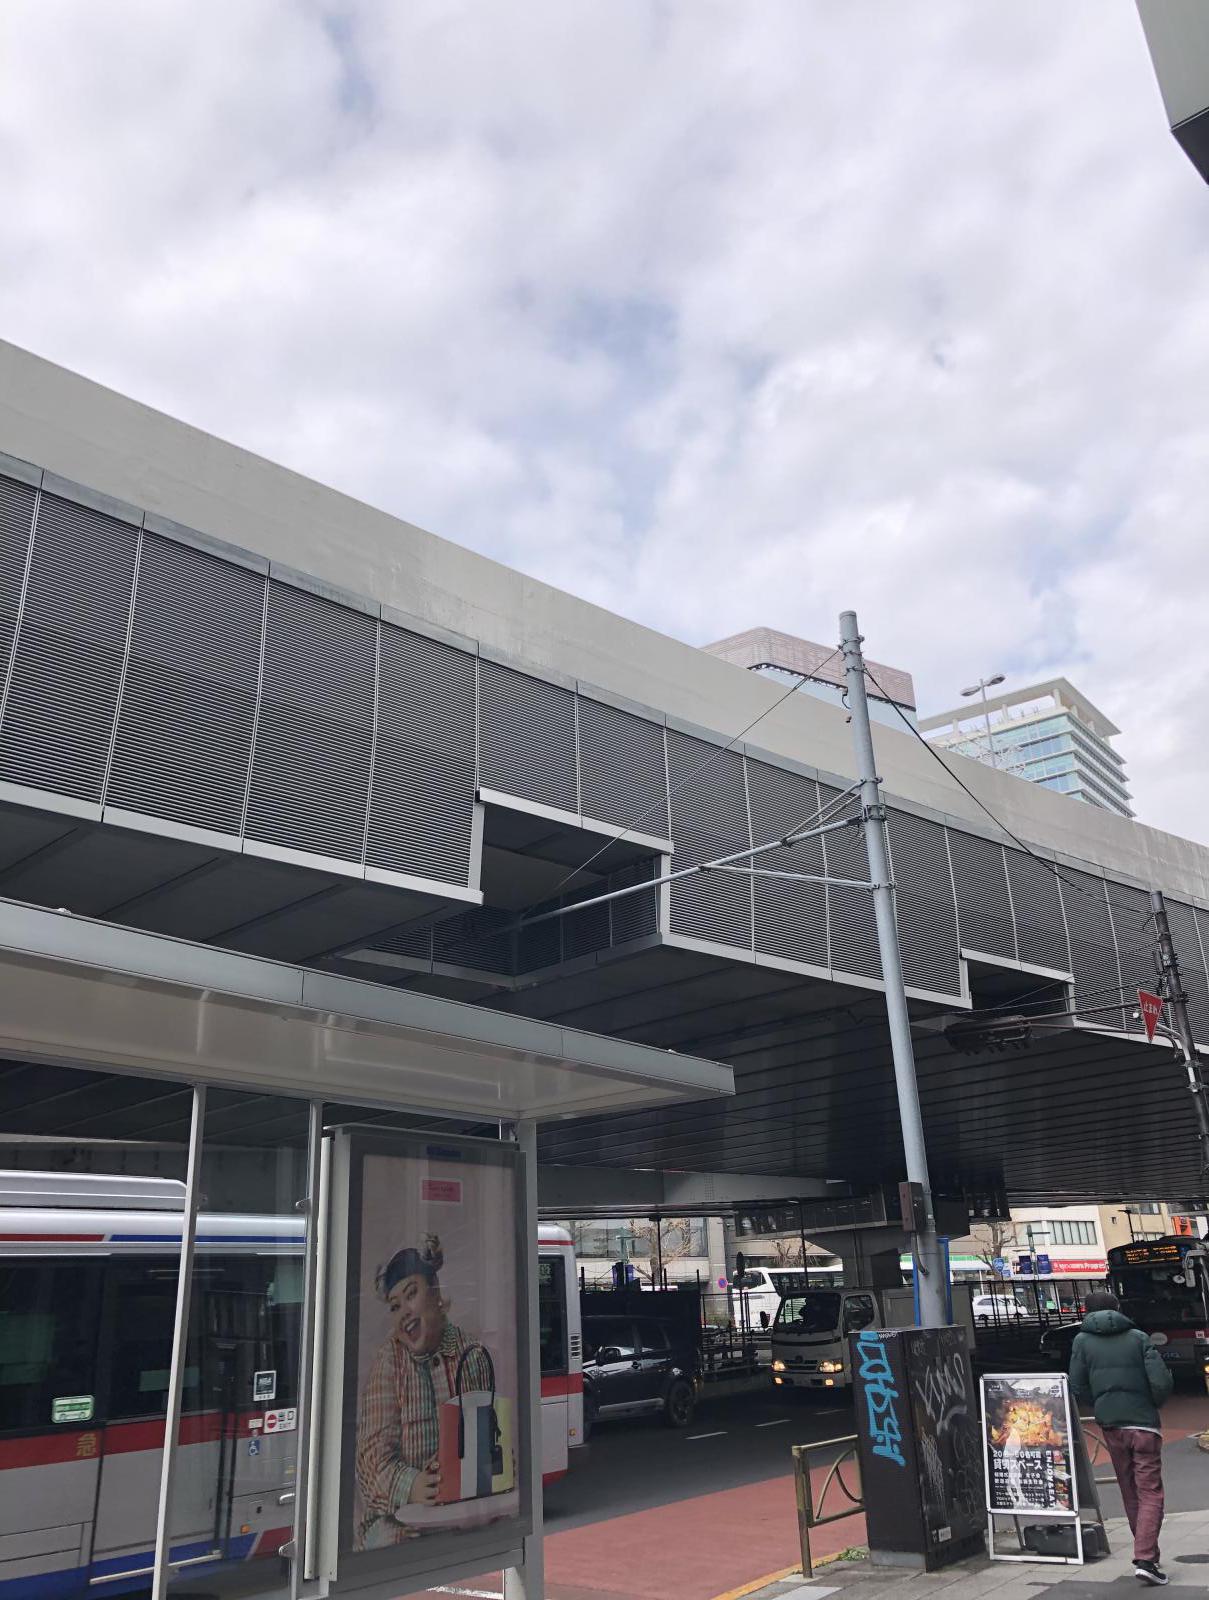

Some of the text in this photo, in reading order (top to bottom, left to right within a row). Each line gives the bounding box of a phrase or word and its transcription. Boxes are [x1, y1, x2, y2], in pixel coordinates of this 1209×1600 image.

[1143, 1000, 1158, 1014] 止まれ
[76, 1433, 97, 1456] 急
[1045, 1450, 1057, 1508] ENJOY&EAT
